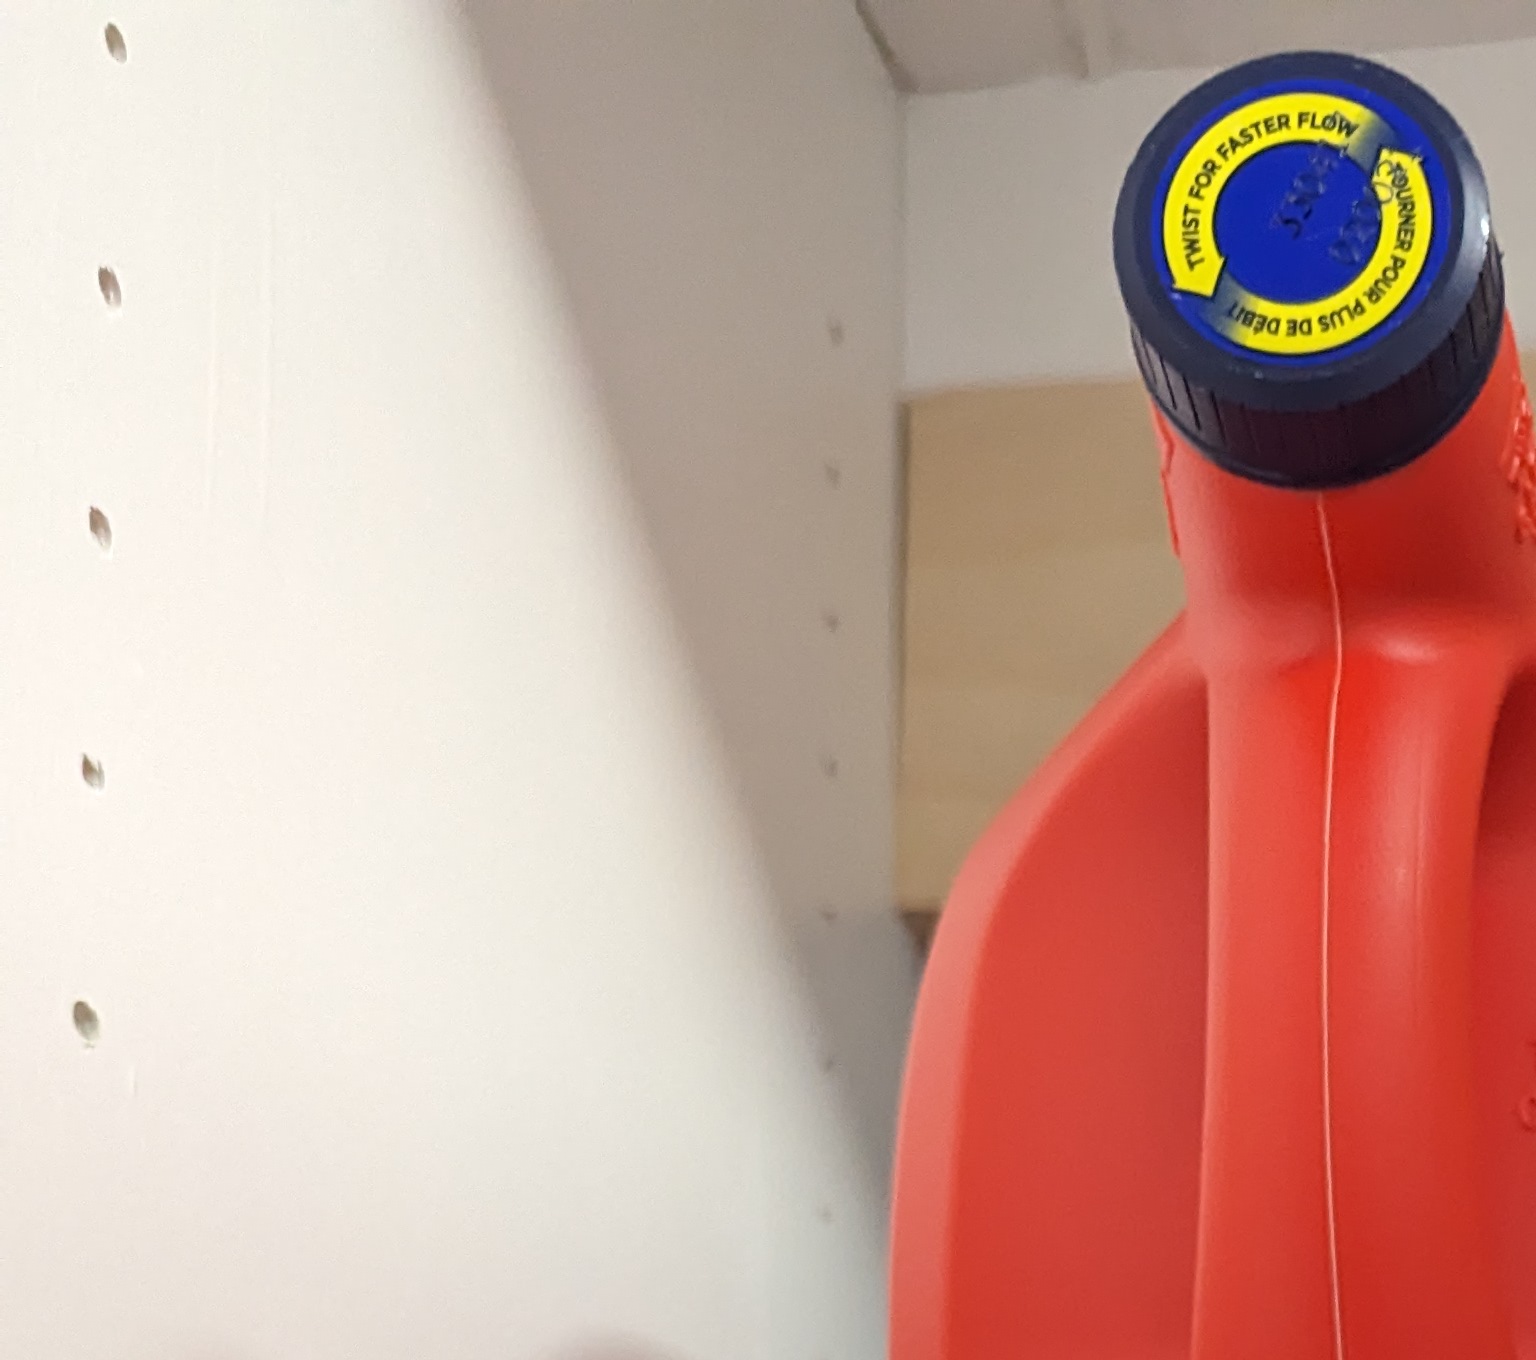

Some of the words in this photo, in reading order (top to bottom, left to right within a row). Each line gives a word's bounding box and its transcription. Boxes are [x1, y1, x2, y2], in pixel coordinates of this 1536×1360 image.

[1216, 113, 1291, 162] FASTER
[1297, 111, 1360, 138] FLOW
[1188, 159, 1221, 201] FOR
[1391, 162, 1416, 252] TOURNER
[1182, 204, 1205, 272] TWIST
[1363, 254, 1406, 304] POUR
[1228, 303, 1280, 335] DÉBIT
[1286, 318, 1312, 337] DE
[1318, 302, 1366, 332] PLUS
